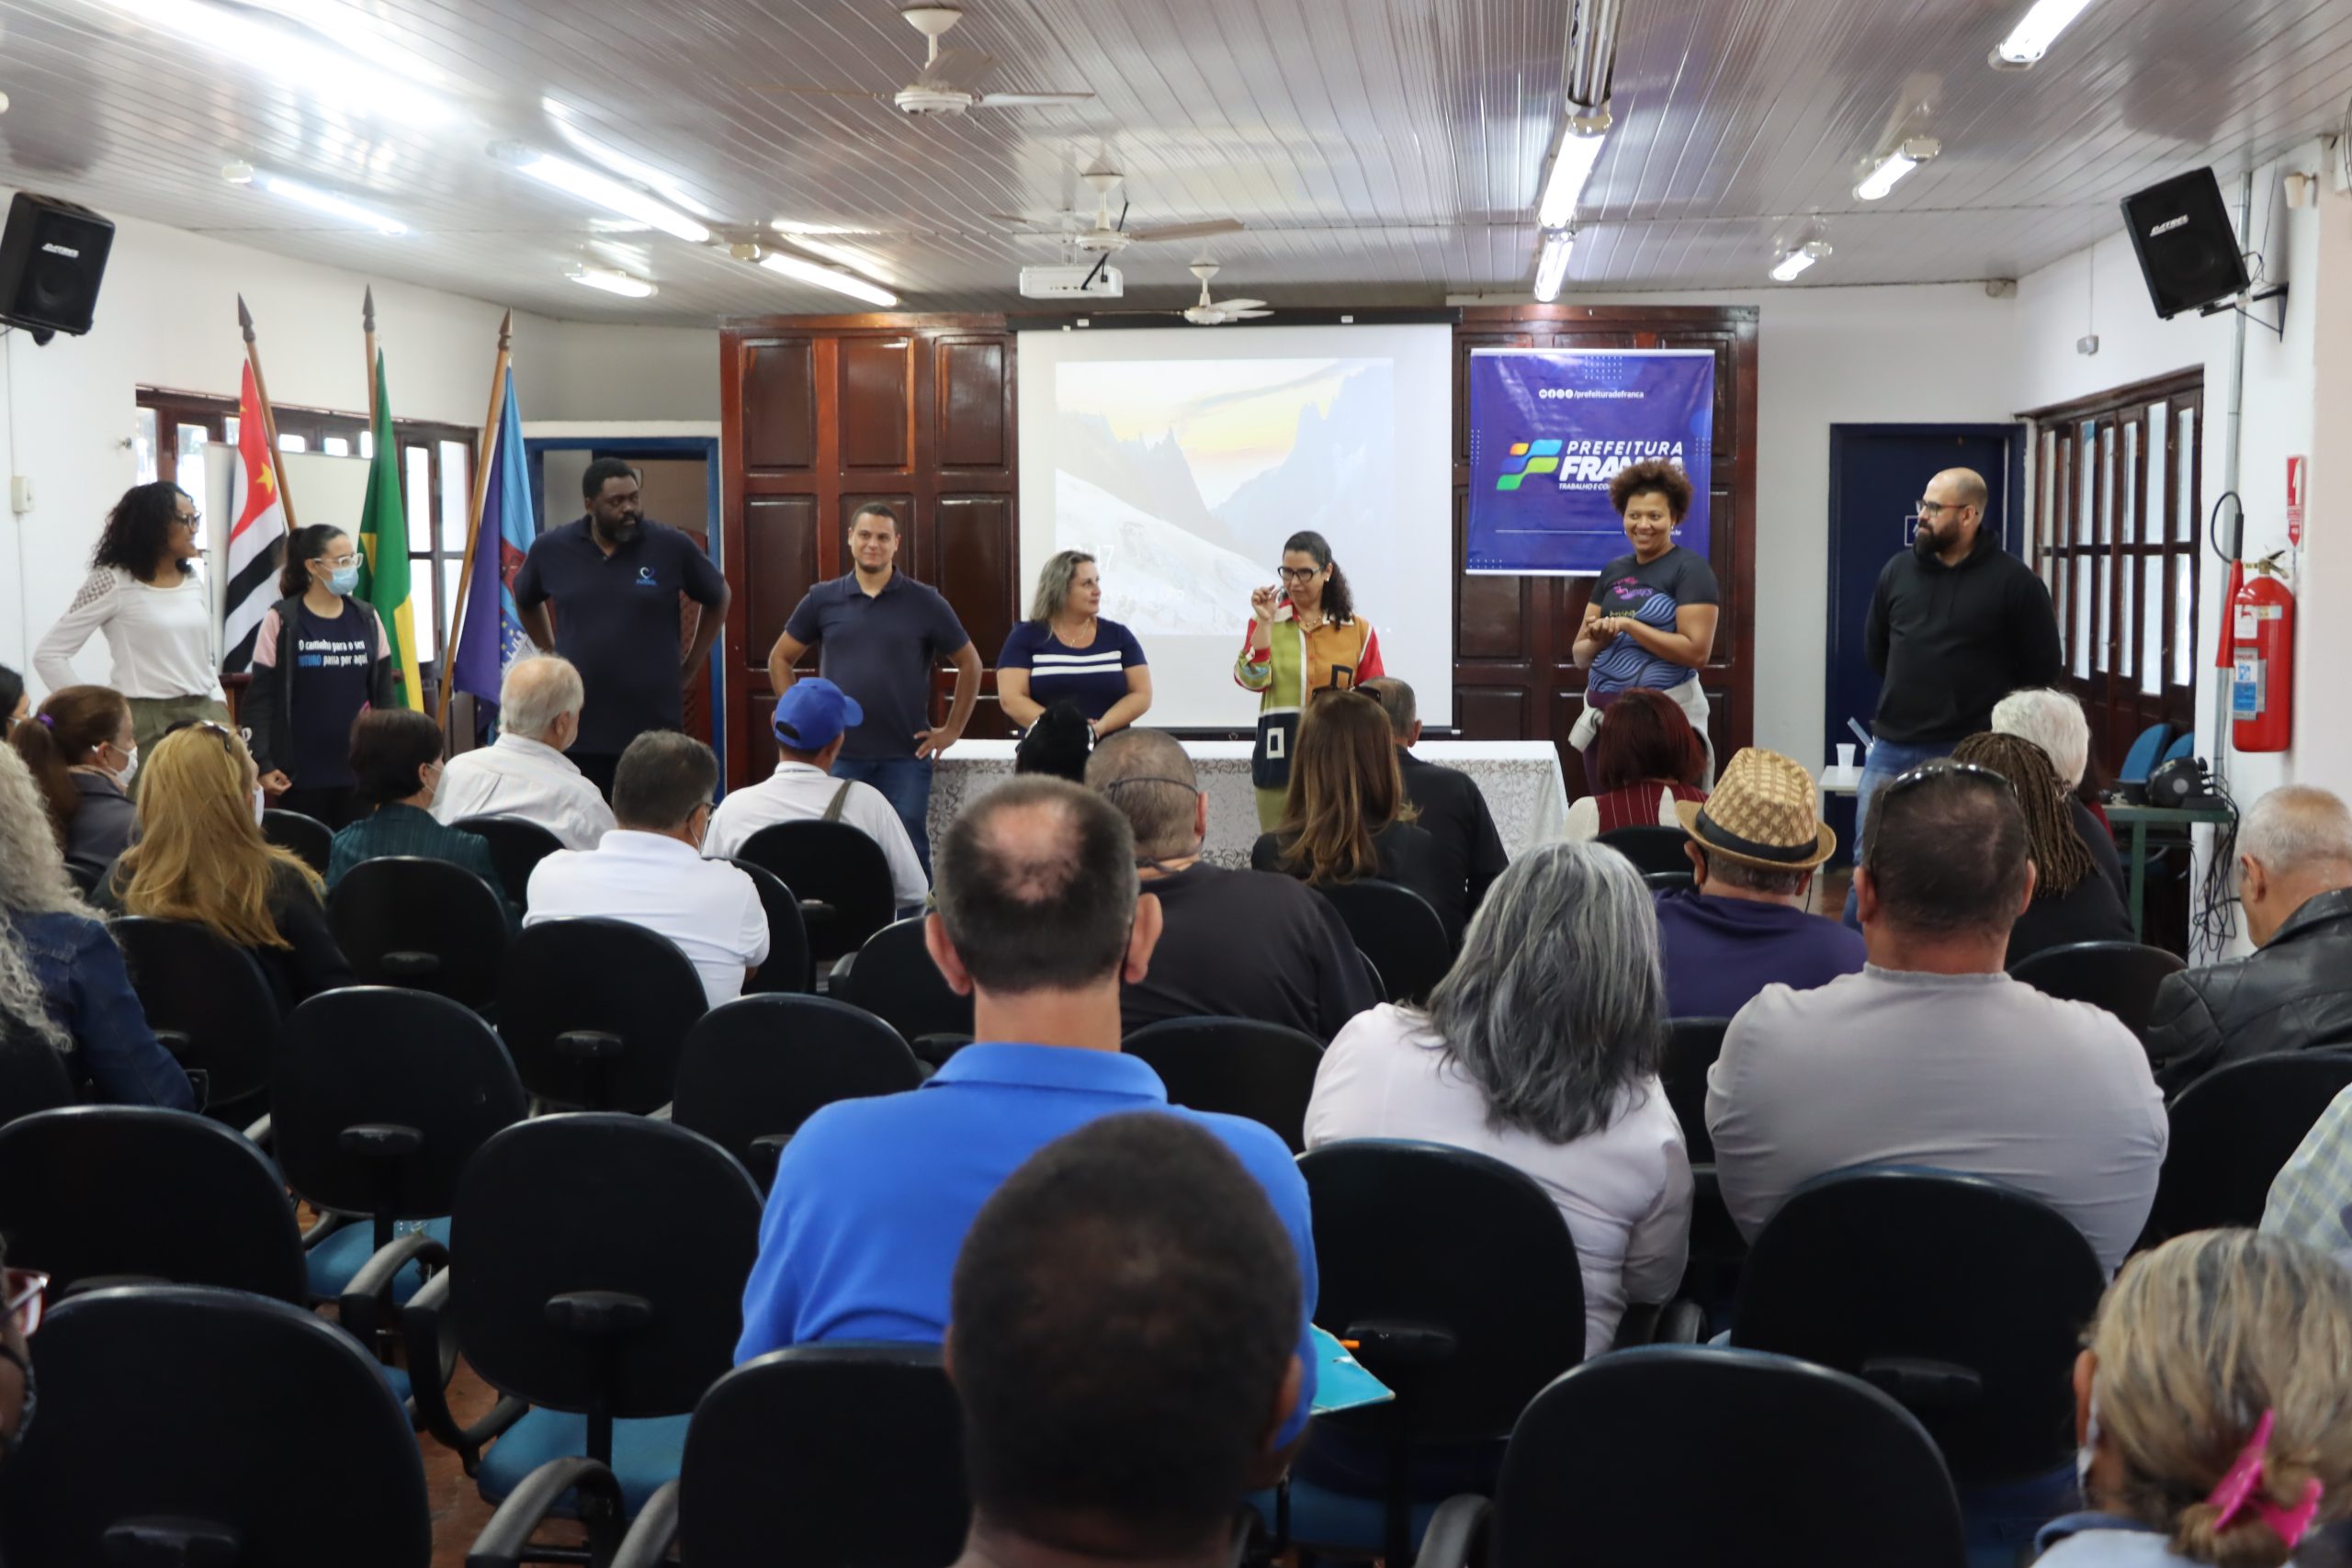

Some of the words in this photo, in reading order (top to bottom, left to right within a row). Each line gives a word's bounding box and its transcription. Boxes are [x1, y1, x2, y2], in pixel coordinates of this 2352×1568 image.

[1566, 440, 1683, 456] PREFEITURA
[1558, 456, 1683, 482] FRA
[1558, 482, 1593, 491] TRABALHO
[299, 639, 305, 651] O
[305, 639, 332, 651] caminho
[332, 641, 348, 653] para
[348, 641, 354, 651] o
[354, 640, 366, 650] seu
[340, 655, 353, 667] por
